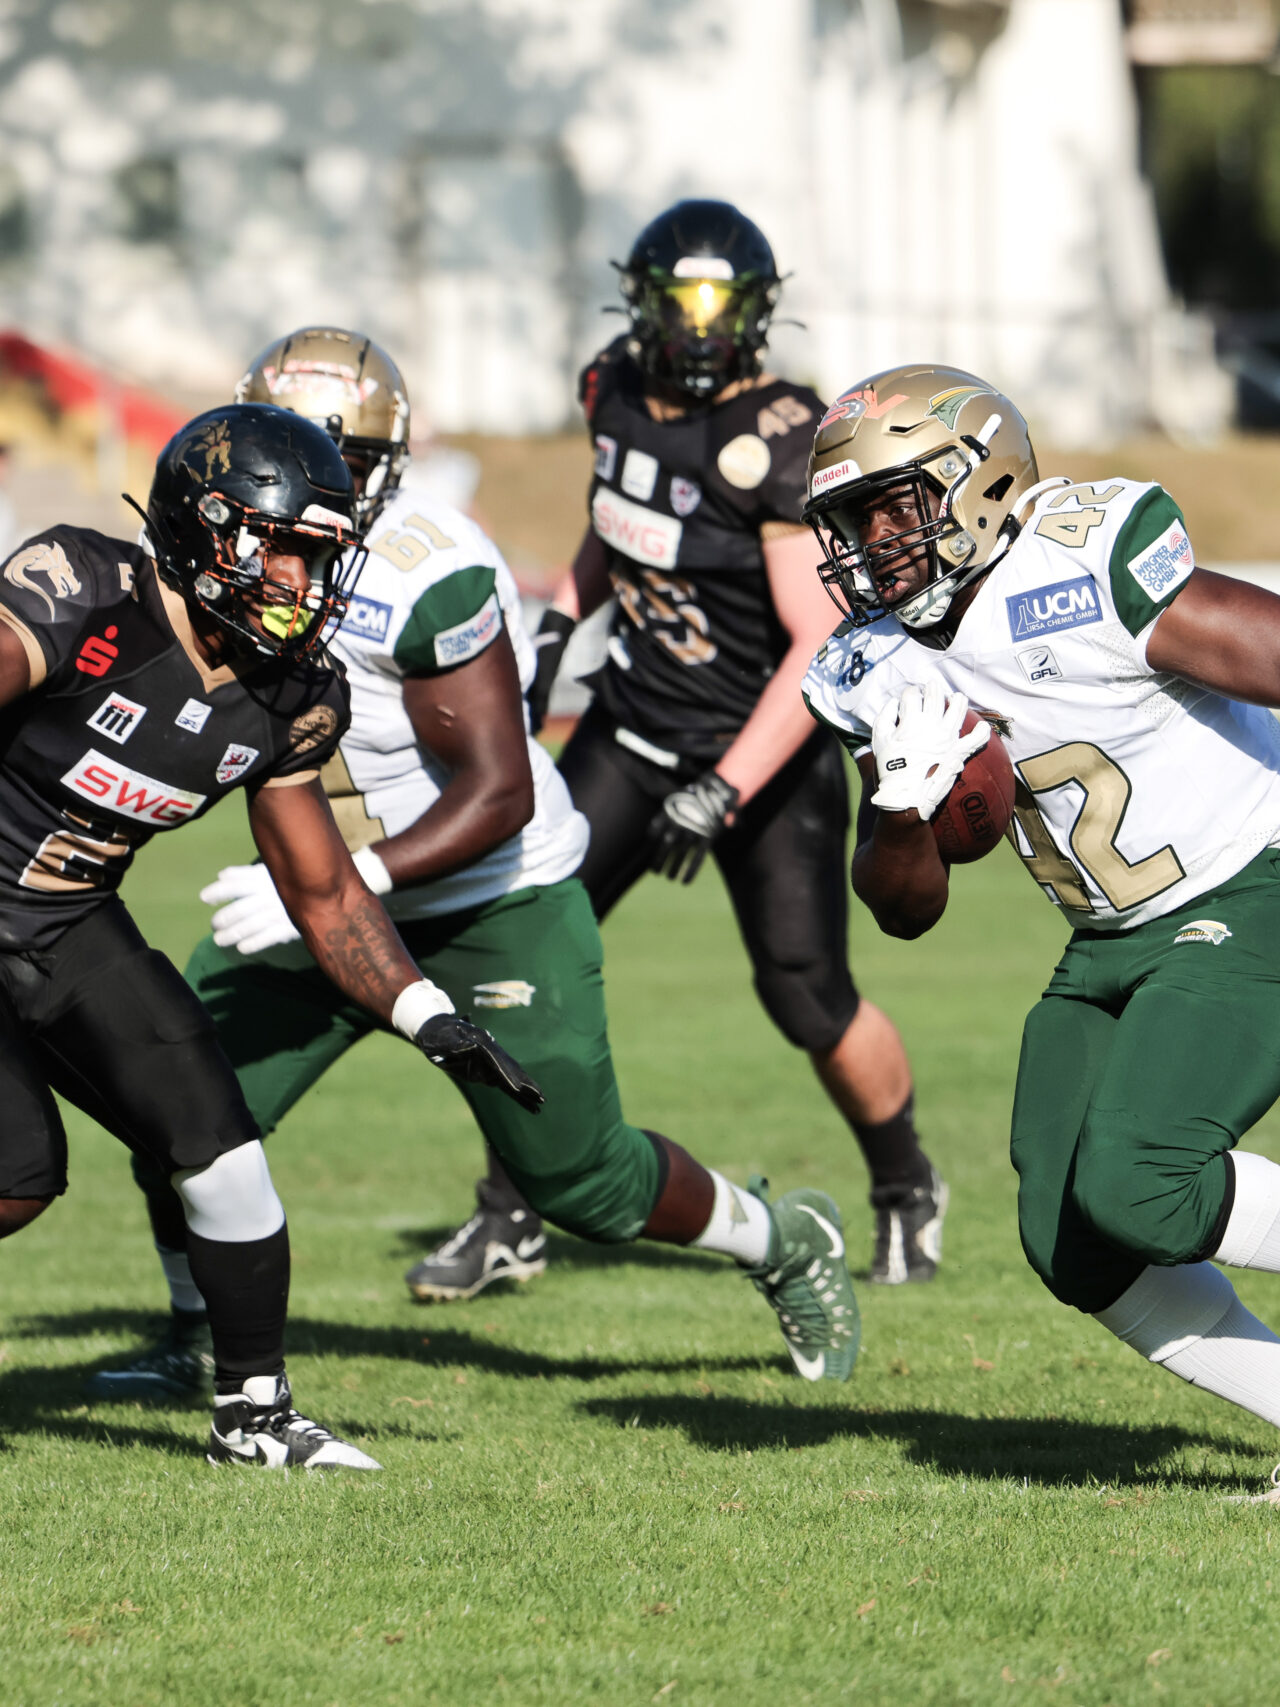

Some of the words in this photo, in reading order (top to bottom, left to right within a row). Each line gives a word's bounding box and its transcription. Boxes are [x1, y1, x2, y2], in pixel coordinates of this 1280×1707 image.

[814, 463, 849, 486] Riddell
[597, 503, 669, 560] SWG
[1034, 485, 1125, 548] 42
[1134, 545, 1171, 577] WAGNER
[1032, 585, 1097, 621] UCM
[1026, 623, 1046, 633] URSA
[1046, 615, 1074, 628] CHEMIE
[1075, 609, 1098, 620] GMBH
[1030, 667, 1058, 681] GFL
[96, 704, 135, 737] fit
[75, 764, 194, 821] SWG
[1010, 741, 1187, 913] 42
